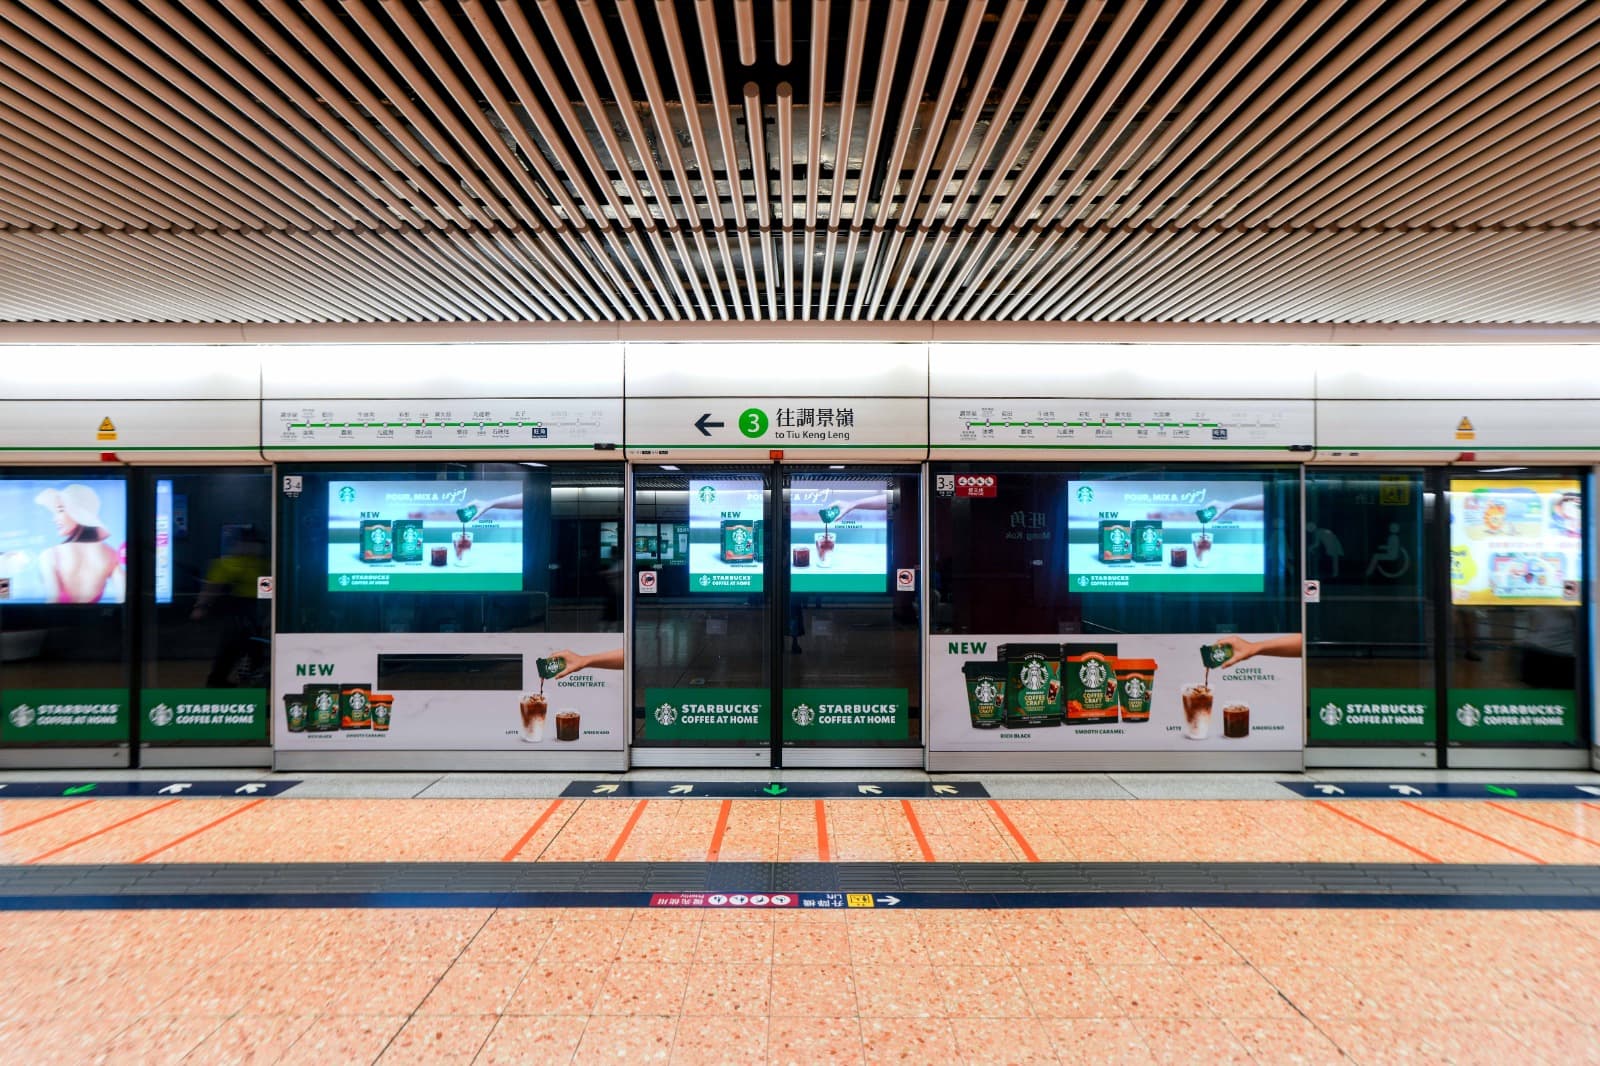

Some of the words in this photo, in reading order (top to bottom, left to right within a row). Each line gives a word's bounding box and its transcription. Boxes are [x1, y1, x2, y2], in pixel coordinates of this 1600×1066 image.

[747, 413, 760, 433] 3
[776, 408, 854, 428] 往調景嶺
[775, 431, 785, 439] to
[786, 430, 800, 439] Tiu
[802, 430, 826, 440] Keng
[828, 430, 850, 440] Leng
[938, 477, 954, 490] 3-5
[948, 642, 987, 654] NEW
[296, 664, 335, 676] NEW
[37, 705, 119, 714] STARBUCKS
[176, 704, 254, 714] STARBUCKS
[681, 704, 759, 714] STARBUCKS
[818, 704, 896, 714] STARBUCKS
[1346, 704, 1424, 714] STARBUCKS
[1483, 705, 1564, 715] STARBUCKS
[36, 715, 73, 725] COFFEE
[73, 715, 87, 725] AT
[87, 715, 118, 725] HOME
[176, 715, 210, 725] COFFEE
[210, 715, 224, 725] AT
[225, 715, 254, 725] HOME
[681, 715, 716, 724] COFFEE
[717, 715, 729, 724] AT
[730, 715, 759, 724] HOME
[818, 715, 853, 724] COFFEE
[854, 715, 867, 724] AT
[867, 715, 896, 724] HOME
[1346, 715, 1380, 725] COFFEE
[1381, 715, 1394, 725] AT
[1395, 715, 1424, 725] HOME
[1483, 716, 1519, 726] COFFEE
[1519, 716, 1532, 726] AT
[1532, 716, 1564, 726] HOME
